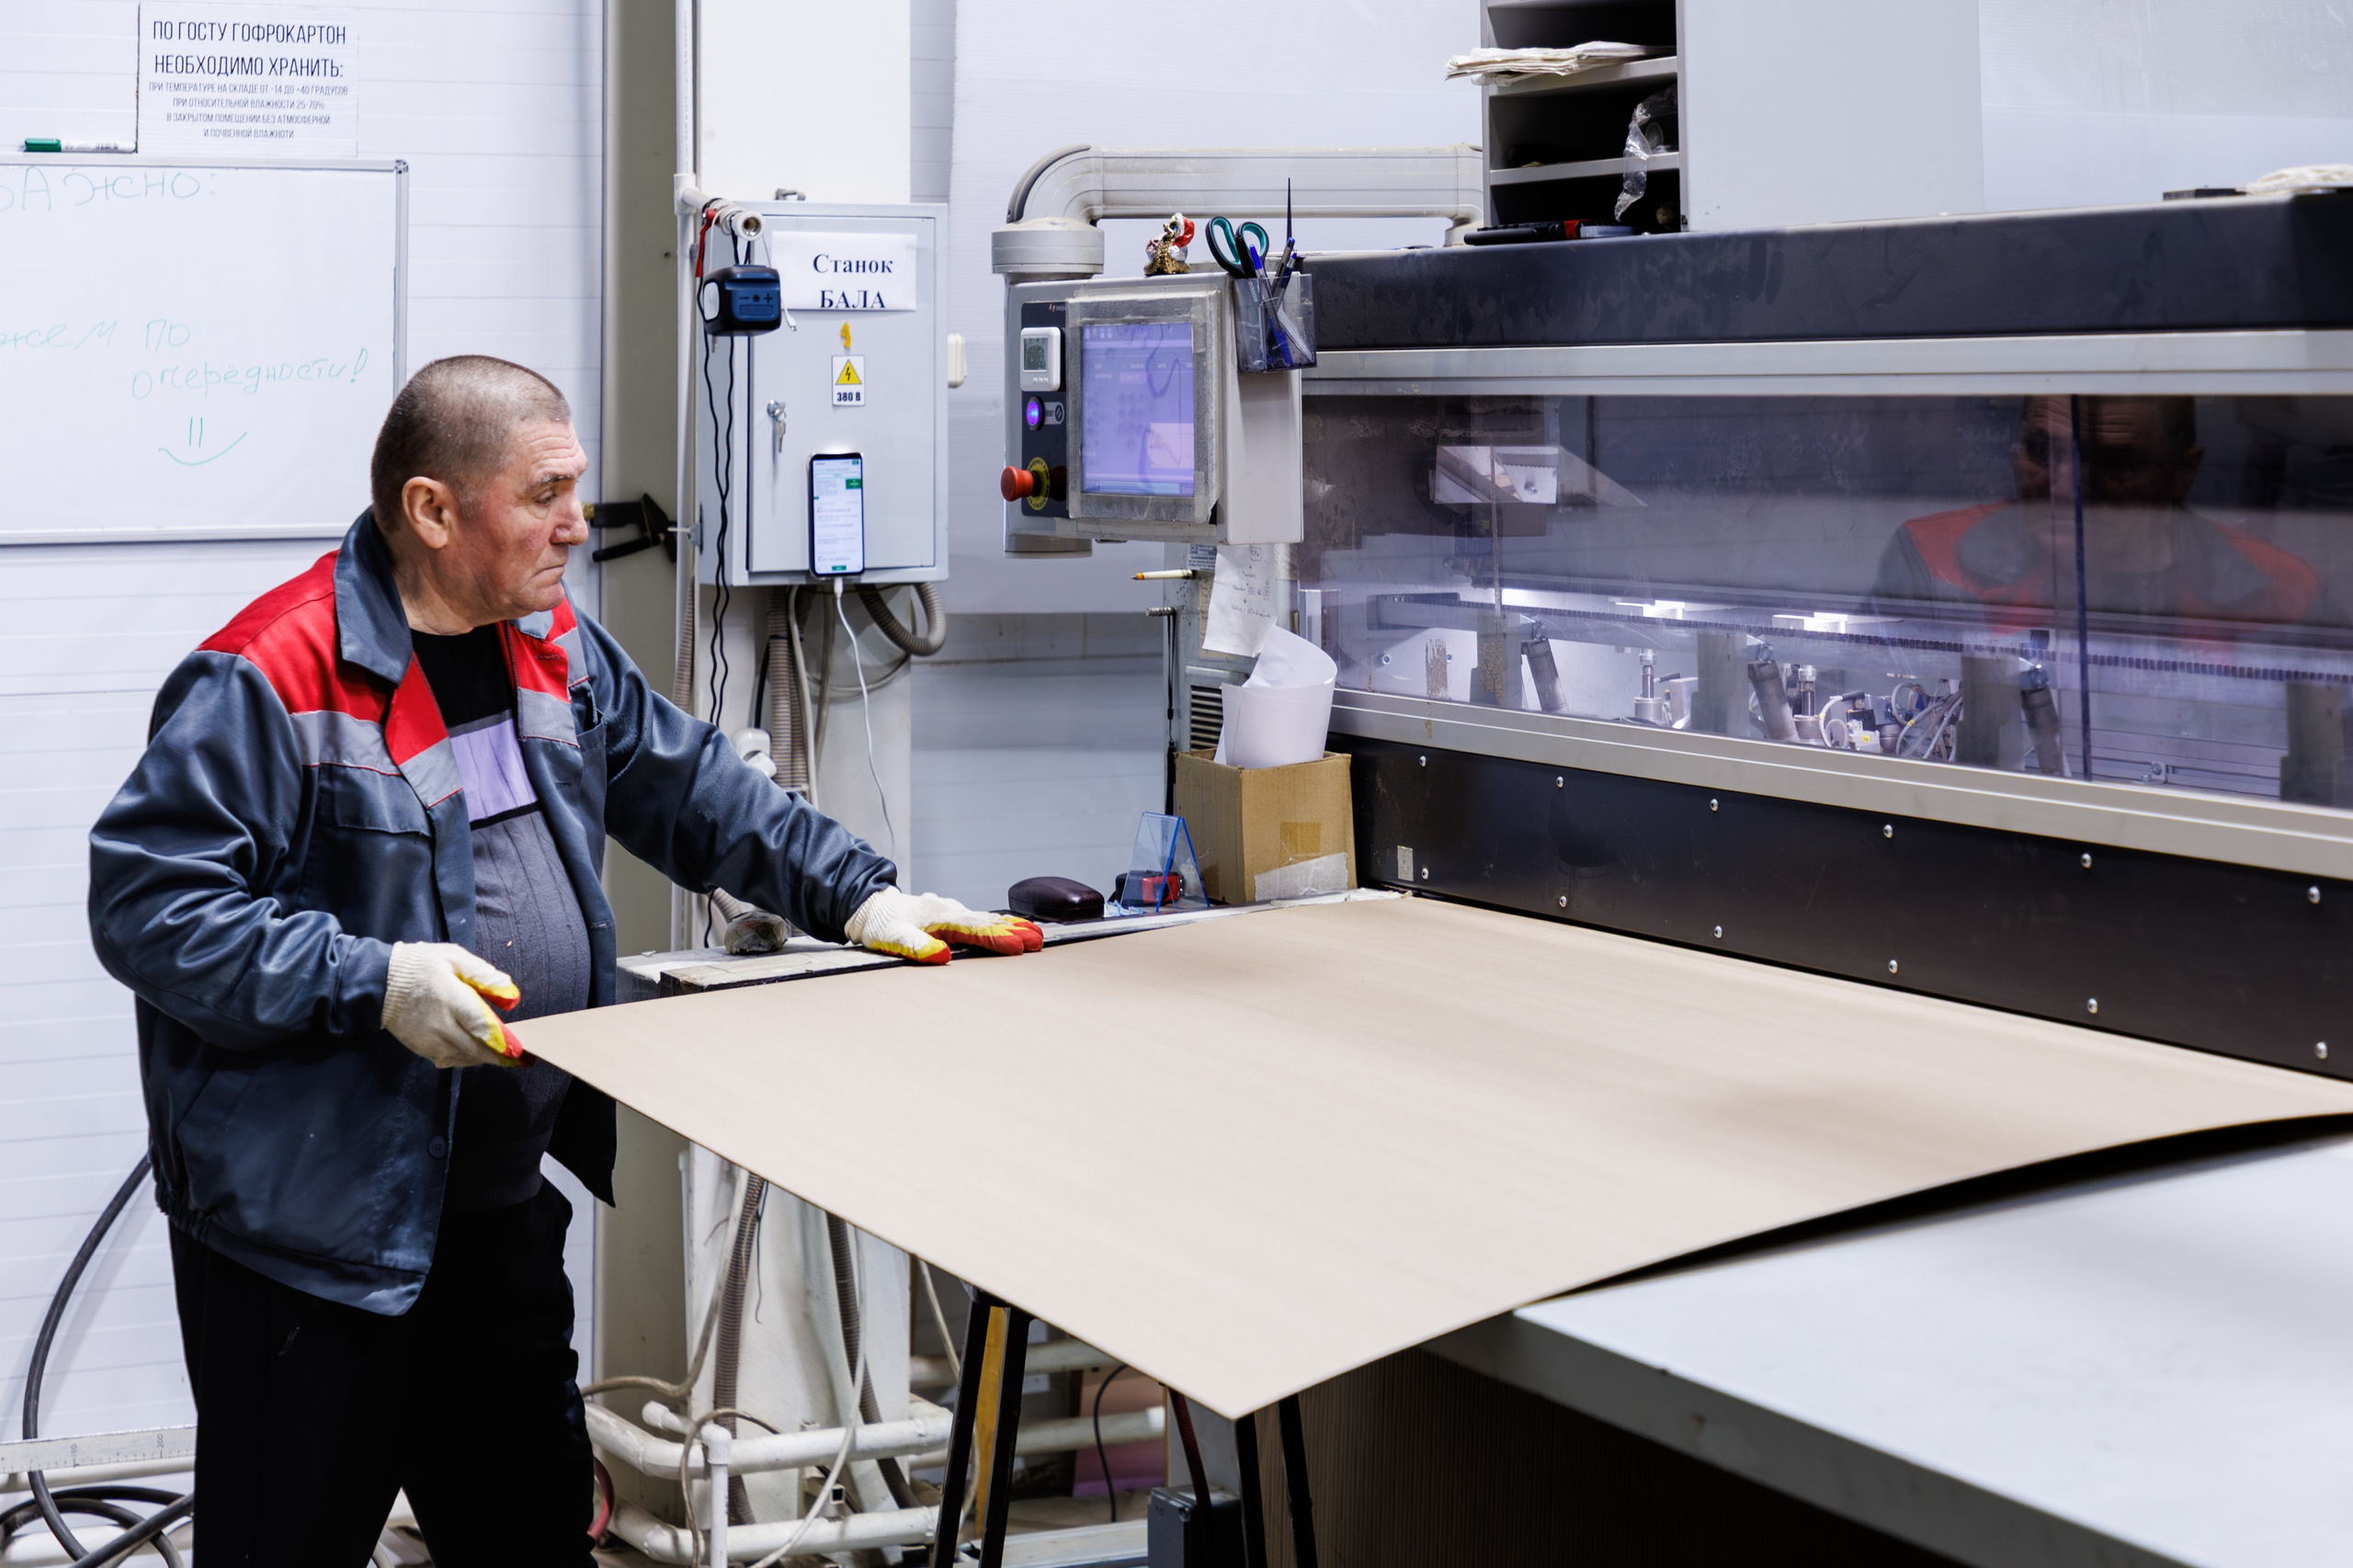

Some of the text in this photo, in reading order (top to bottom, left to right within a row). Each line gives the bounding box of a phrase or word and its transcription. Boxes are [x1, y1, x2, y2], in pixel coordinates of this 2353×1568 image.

[153, 20, 347, 44] ПО ГОСТУ ГОФРОКАРТОН
[154, 54, 344, 78] НЕОБХОДИМО ХРАНИТЬ:
[149, 82, 164, 92] ПРИ
[165, 82, 216, 93] ТЕМПЕРАТУРЕ
[218, 83, 227, 93] НА
[229, 83, 258, 95] СКЛАДЕ
[259, 84, 268, 94] ОТ
[284, 85, 294, 95] ДО
[312, 85, 348, 96] ГРАДУСОВ
[173, 97, 188, 107] ПРИ
[188, 97, 249, 108] ОТНОСИТЕЛЬНОЙ
[250, 98, 295, 108] ВЛАЖНОСТИ
[166, 112, 331, 124] В ЗАКРЫТОМ ПОМЕЩЕНИИ БЕЗ АТМОСФЕРНОЙ
[203, 129, 210, 137] И
[813, 253, 894, 274] Станок
[820, 290, 886, 309] БАЛА
[836, 392, 854, 402] 380
